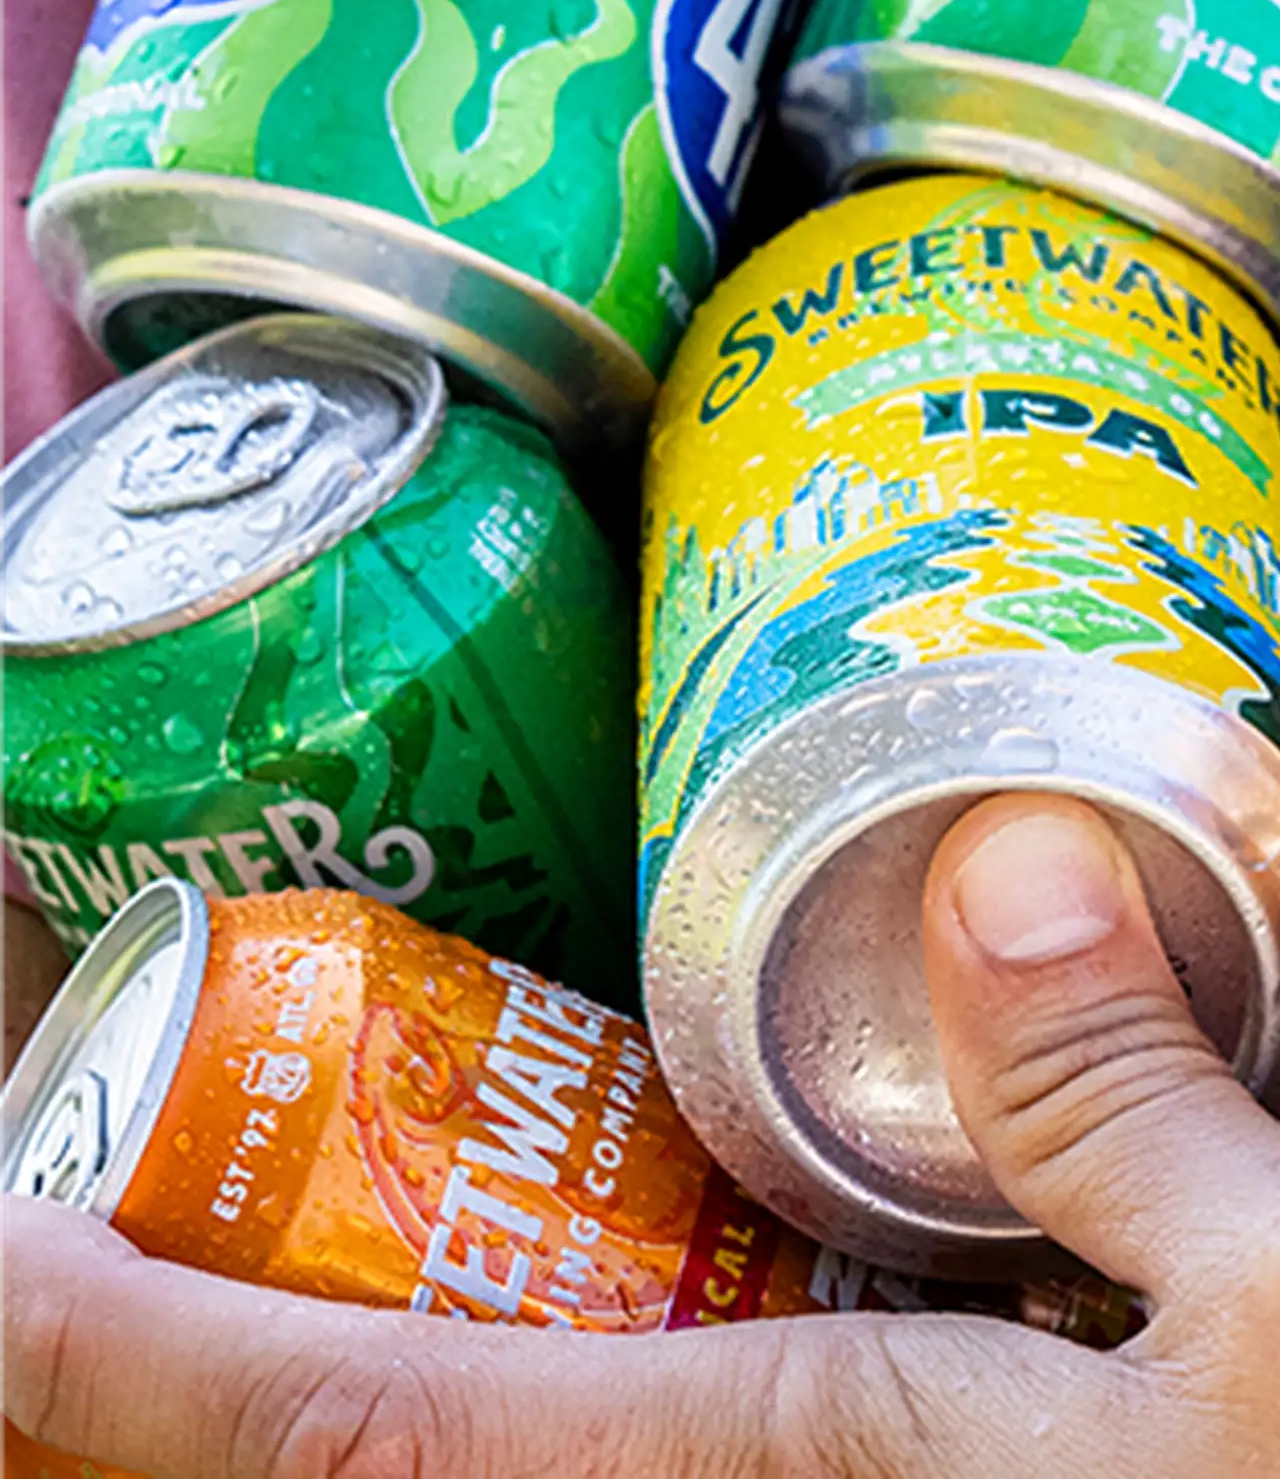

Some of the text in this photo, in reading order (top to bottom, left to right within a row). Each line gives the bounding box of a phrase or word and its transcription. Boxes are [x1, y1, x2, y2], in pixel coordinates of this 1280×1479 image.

[1155, 11, 1262, 86] THE
[920, 388, 1200, 490] IPA
[209, 1161, 255, 1223] EST
